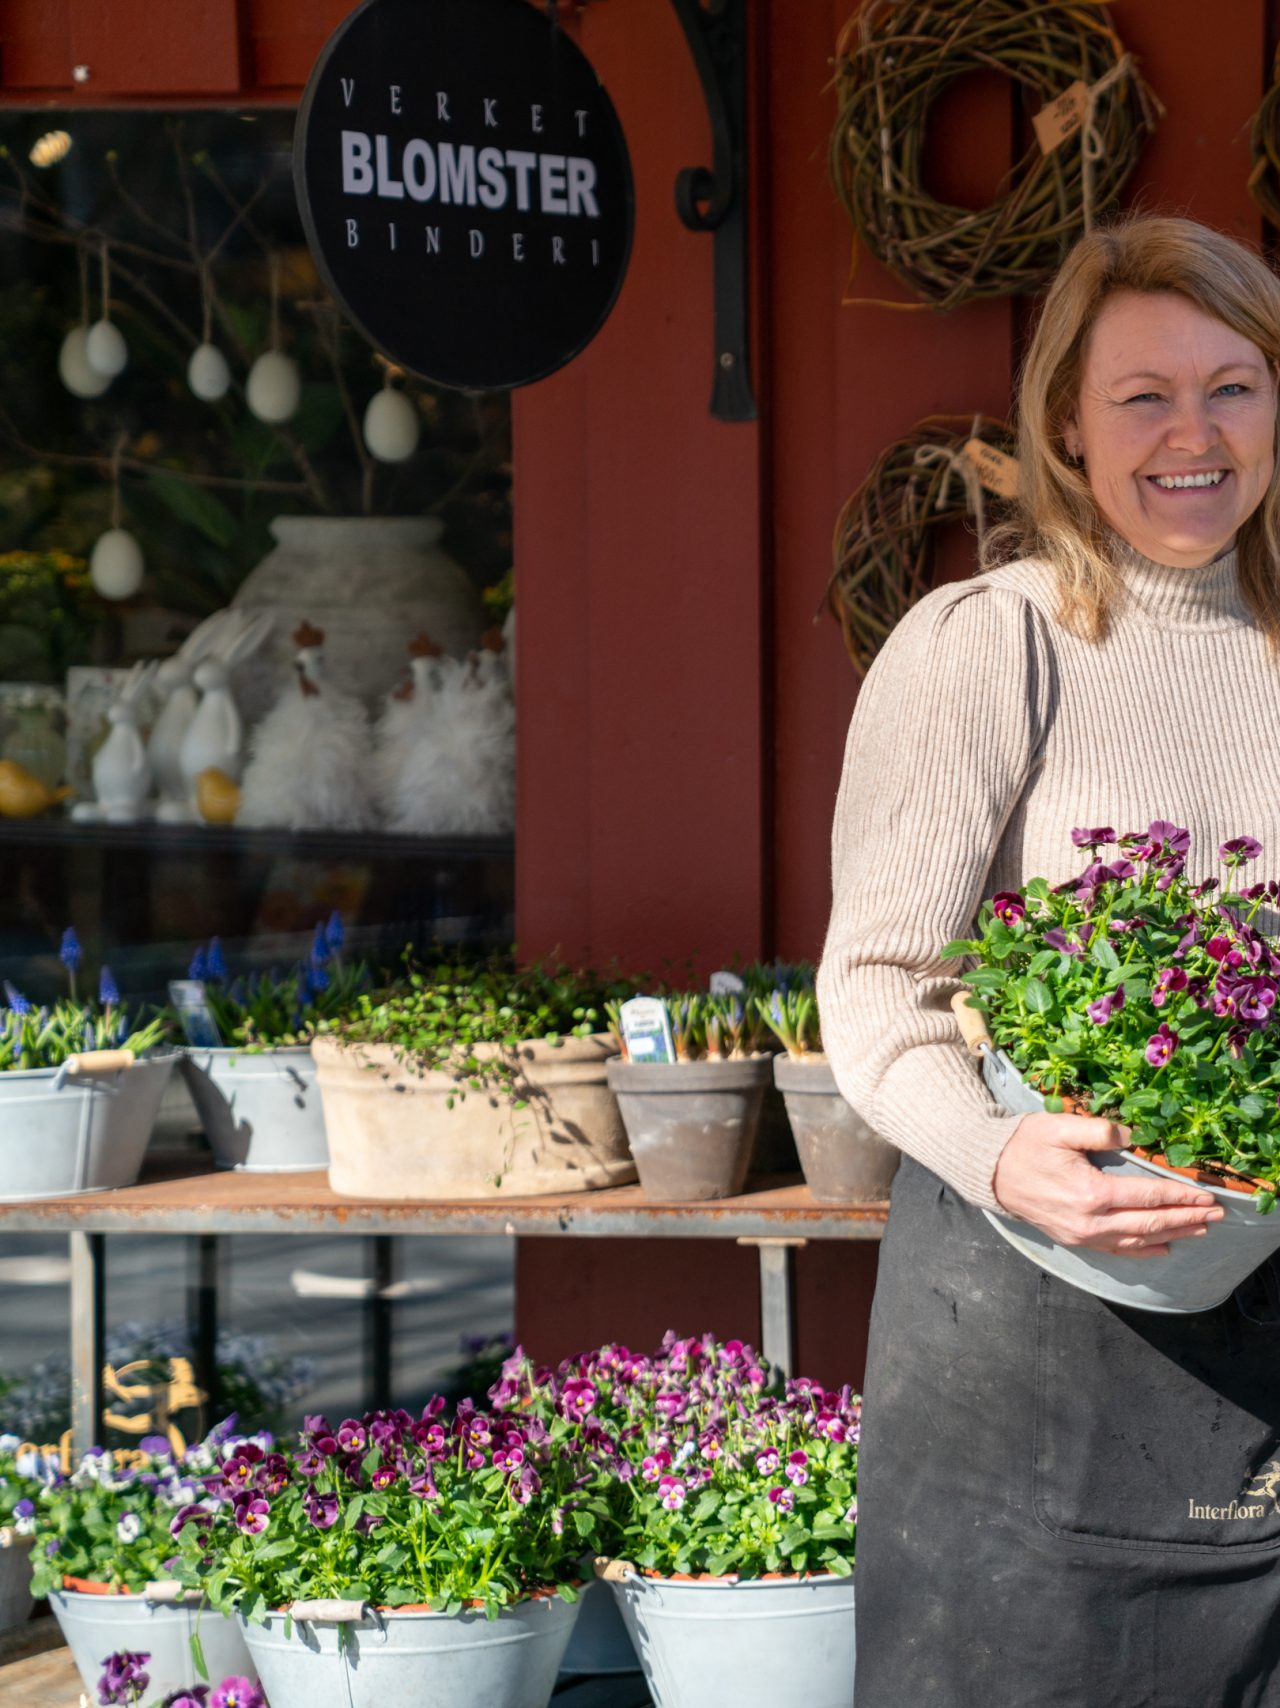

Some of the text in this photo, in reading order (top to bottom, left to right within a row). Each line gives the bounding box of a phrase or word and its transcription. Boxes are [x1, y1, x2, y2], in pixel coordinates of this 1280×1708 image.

[340, 77, 589, 138] VERKET
[340, 129, 600, 218] BLOMSTER
[345, 218, 599, 267] BINDERI
[1187, 1498, 1265, 1520] Interflora
